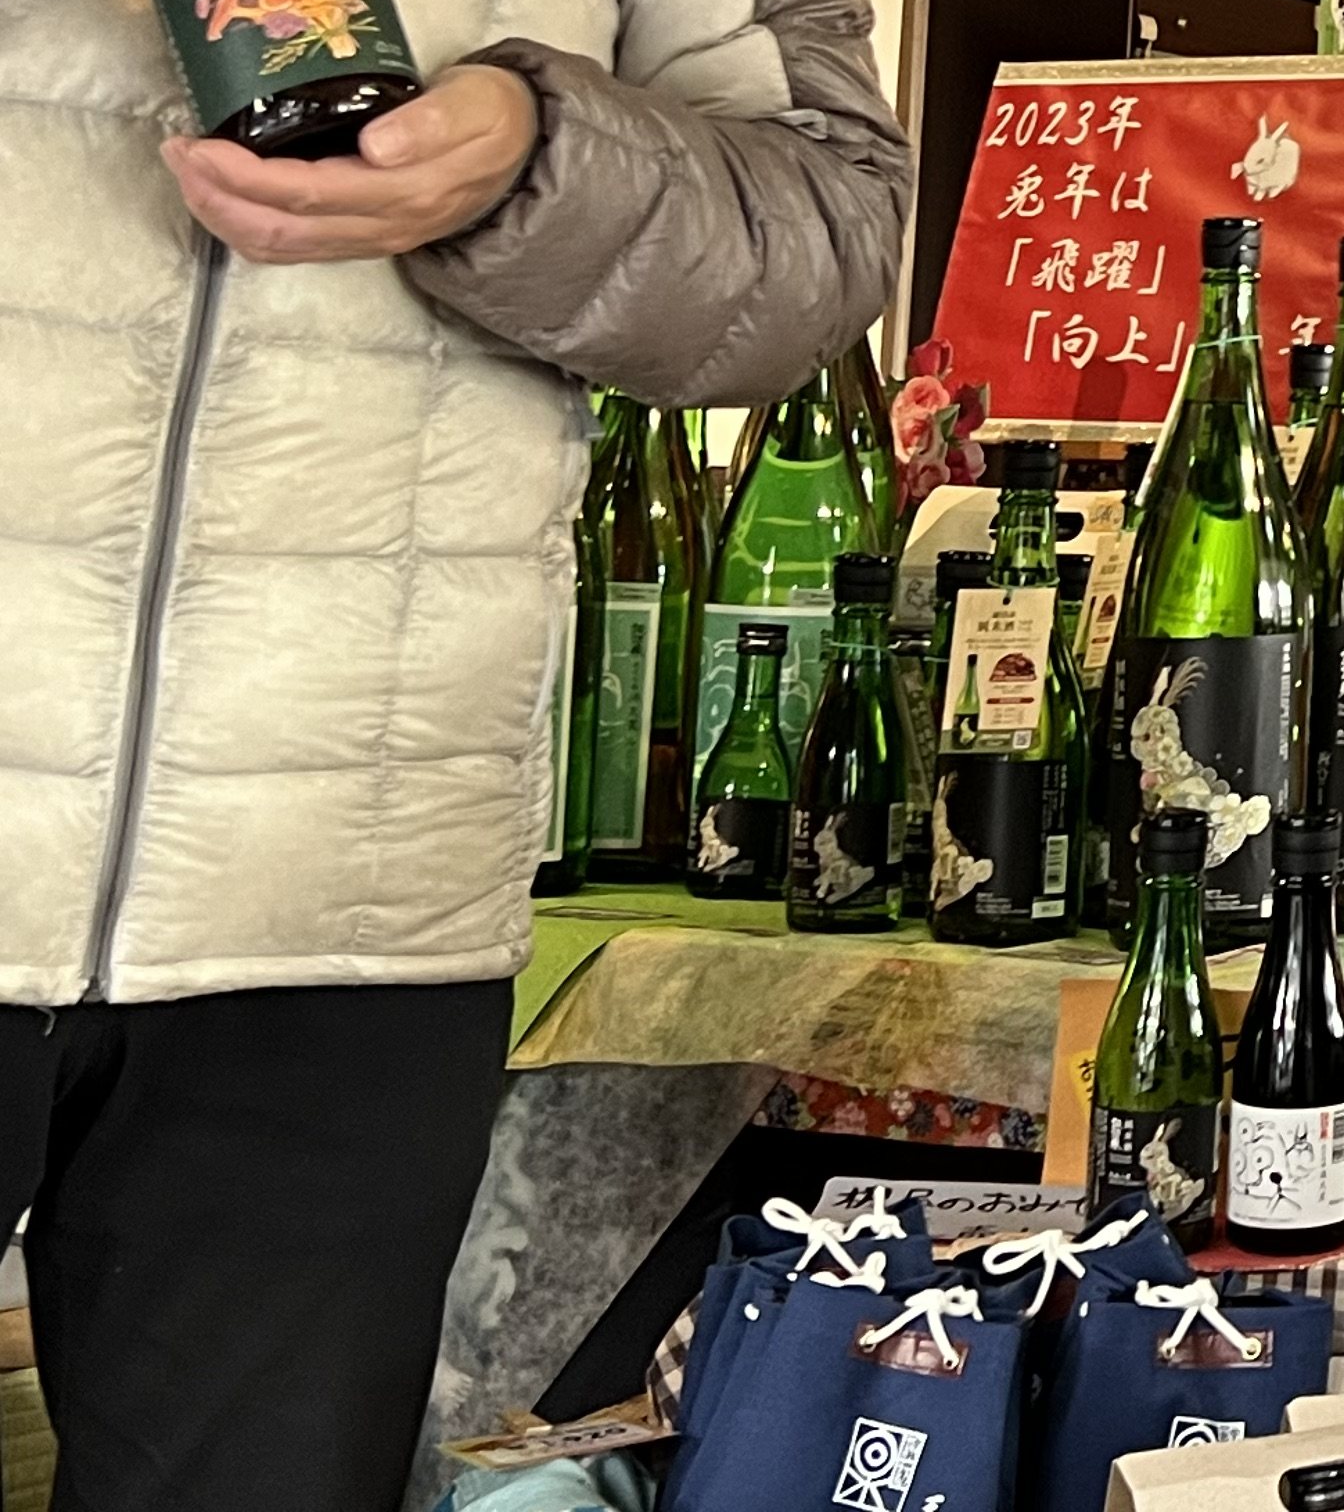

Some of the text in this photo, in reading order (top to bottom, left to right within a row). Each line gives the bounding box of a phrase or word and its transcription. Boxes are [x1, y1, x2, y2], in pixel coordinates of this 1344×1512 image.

[985, 94, 1142, 152] 2023年
[997, 161, 1153, 221] 兎年は
[1005, 237, 1166, 295] 「飛躍」
[1023, 310, 1186, 372] 「向上」
